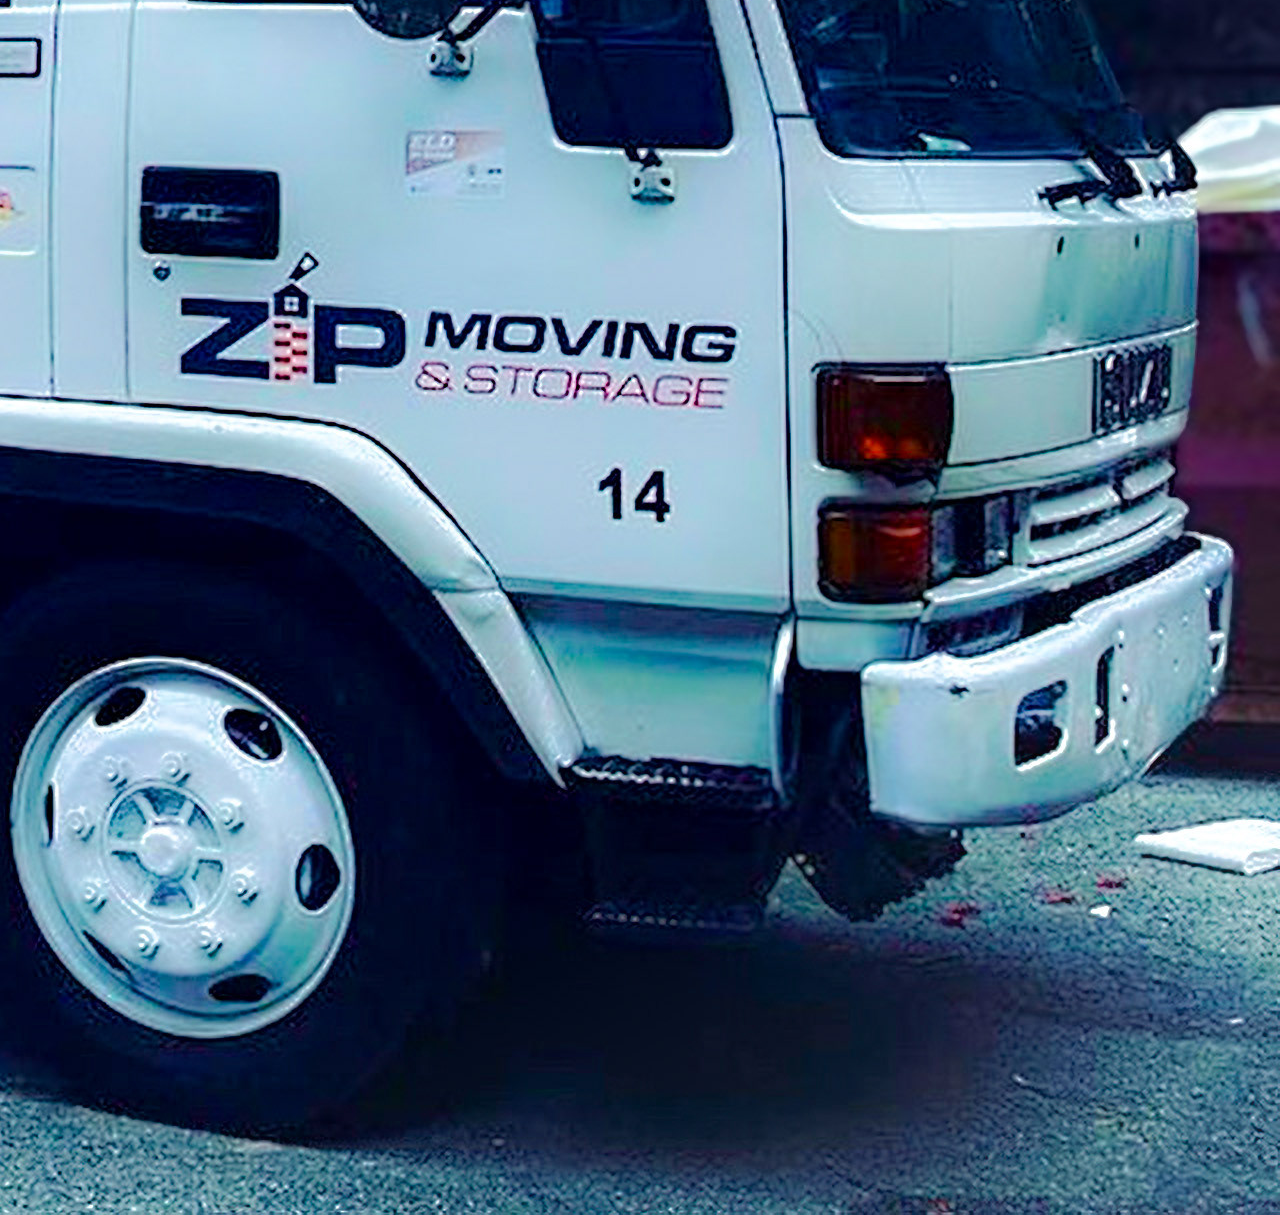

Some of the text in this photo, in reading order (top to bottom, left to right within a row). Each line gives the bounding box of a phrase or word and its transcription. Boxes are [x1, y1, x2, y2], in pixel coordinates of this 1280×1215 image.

[424, 311, 738, 363] MOVING
[415, 362, 731, 410] & STORAGE
[598, 468, 671, 522] 14
